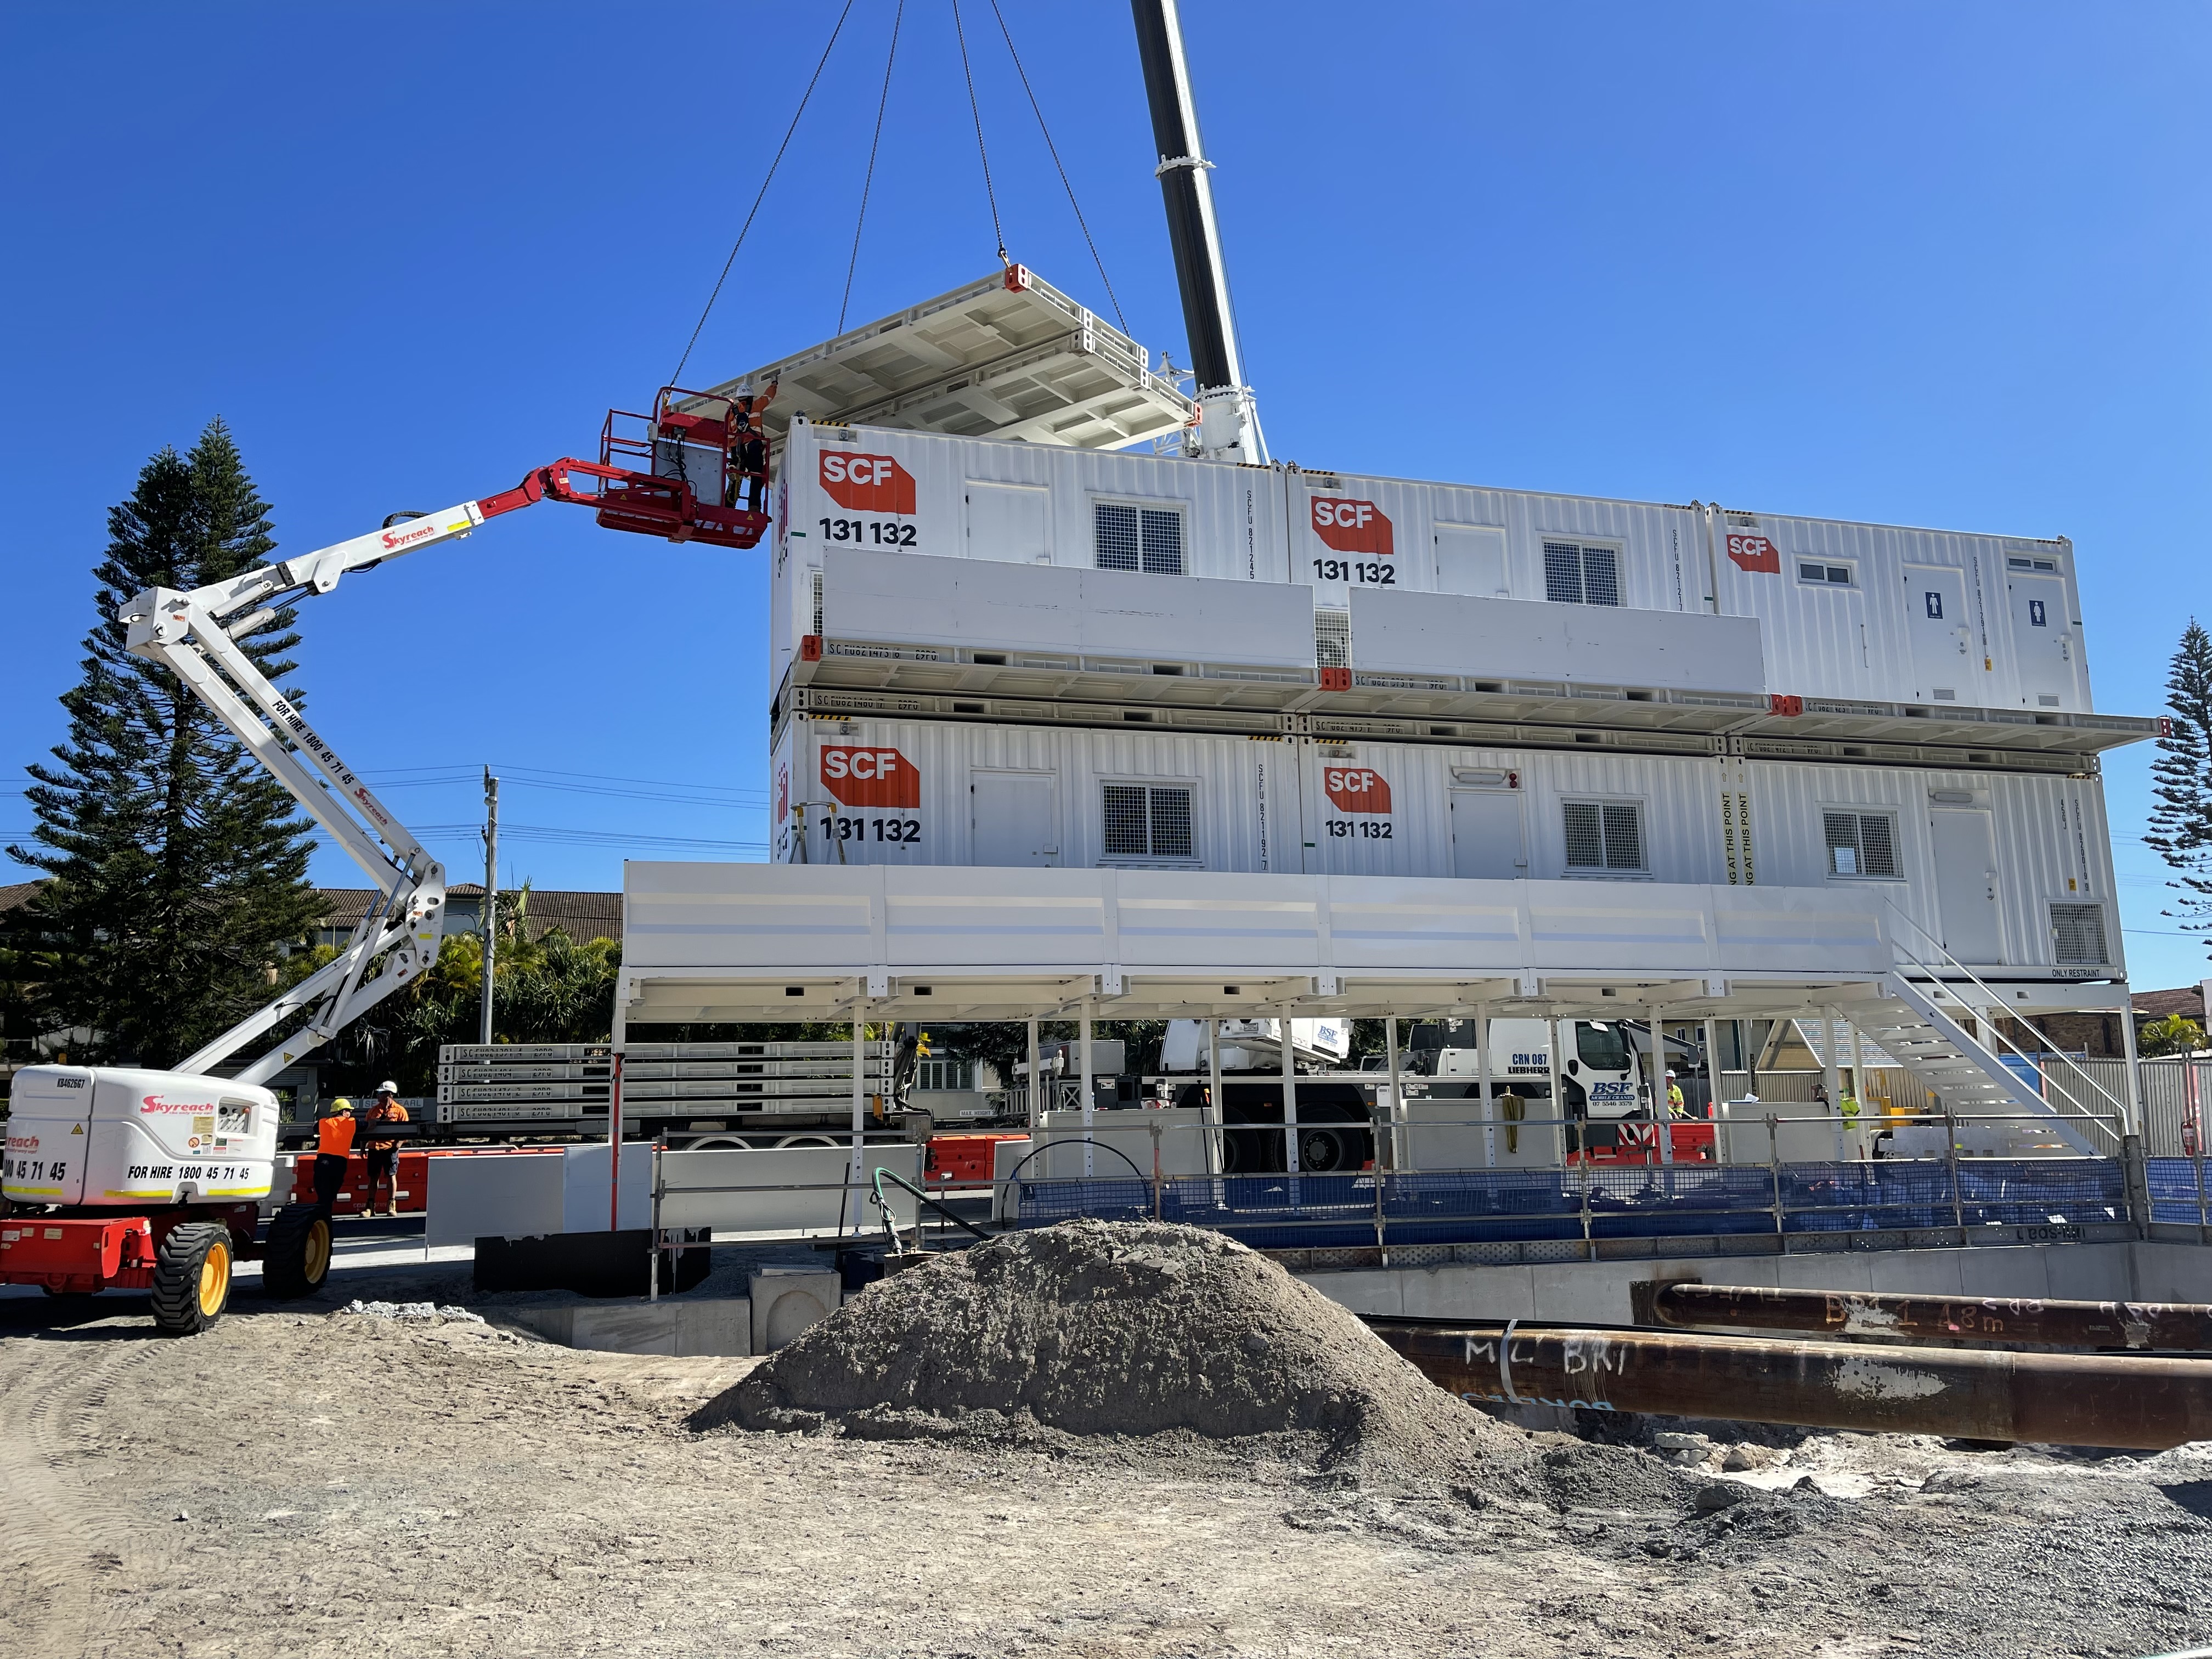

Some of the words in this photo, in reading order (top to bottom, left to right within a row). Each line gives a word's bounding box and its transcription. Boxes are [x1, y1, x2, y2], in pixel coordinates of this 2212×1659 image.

[823, 456, 892, 486] SCF
[1315, 501, 1373, 529] SCF
[382, 526, 433, 549] Skyreach
[820, 518, 862, 543] 131
[870, 522, 917, 546] 132
[1730, 537, 1767, 556] SCF
[1313, 558, 1348, 582] 131
[1356, 563, 1395, 584] 132
[272, 700, 290, 716] FOR
[285, 714, 306, 732] HIRE
[303, 732, 323, 751] 1800
[321, 752, 334, 763] 45
[330, 761, 344, 774] 71
[341, 774, 355, 785] 45
[825, 751, 896, 780] SCF
[1329, 771, 1373, 793] SCF
[354, 788, 387, 825] Skyreach
[1723, 793, 1732, 825] POINT
[1739, 794, 1748, 825] POINT
[820, 817, 864, 841] 131
[872, 819, 921, 843] 132
[1325, 821, 1354, 837] 131
[1359, 822, 1392, 839] 132
[1726, 828, 1734, 852] THIS
[1742, 829, 1751, 853] THIS
[1728, 855, 1735, 869] AT
[1745, 856, 1752, 869] AT
[2052, 969, 2067, 977] ONLY
[1508, 1066, 1550, 1074] LIEBHERR
[1513, 1053, 1530, 1065] CRN
[1532, 1054, 1547, 1065] 087
[1591, 1082, 1633, 1094] BSF
[140, 1095, 213, 1114] Skyreach
[16, 1161, 27, 1179] 45
[31, 1162, 43, 1180] 71
[49, 1163, 66, 1181] 45
[128, 1166, 147, 1178] FOR
[150, 1166, 173, 1178] HIRE
[179, 1166, 201, 1179] 1800
[206, 1167, 218, 1179] 45
[223, 1167, 234, 1179] 71
[239, 1168, 249, 1179] 45
